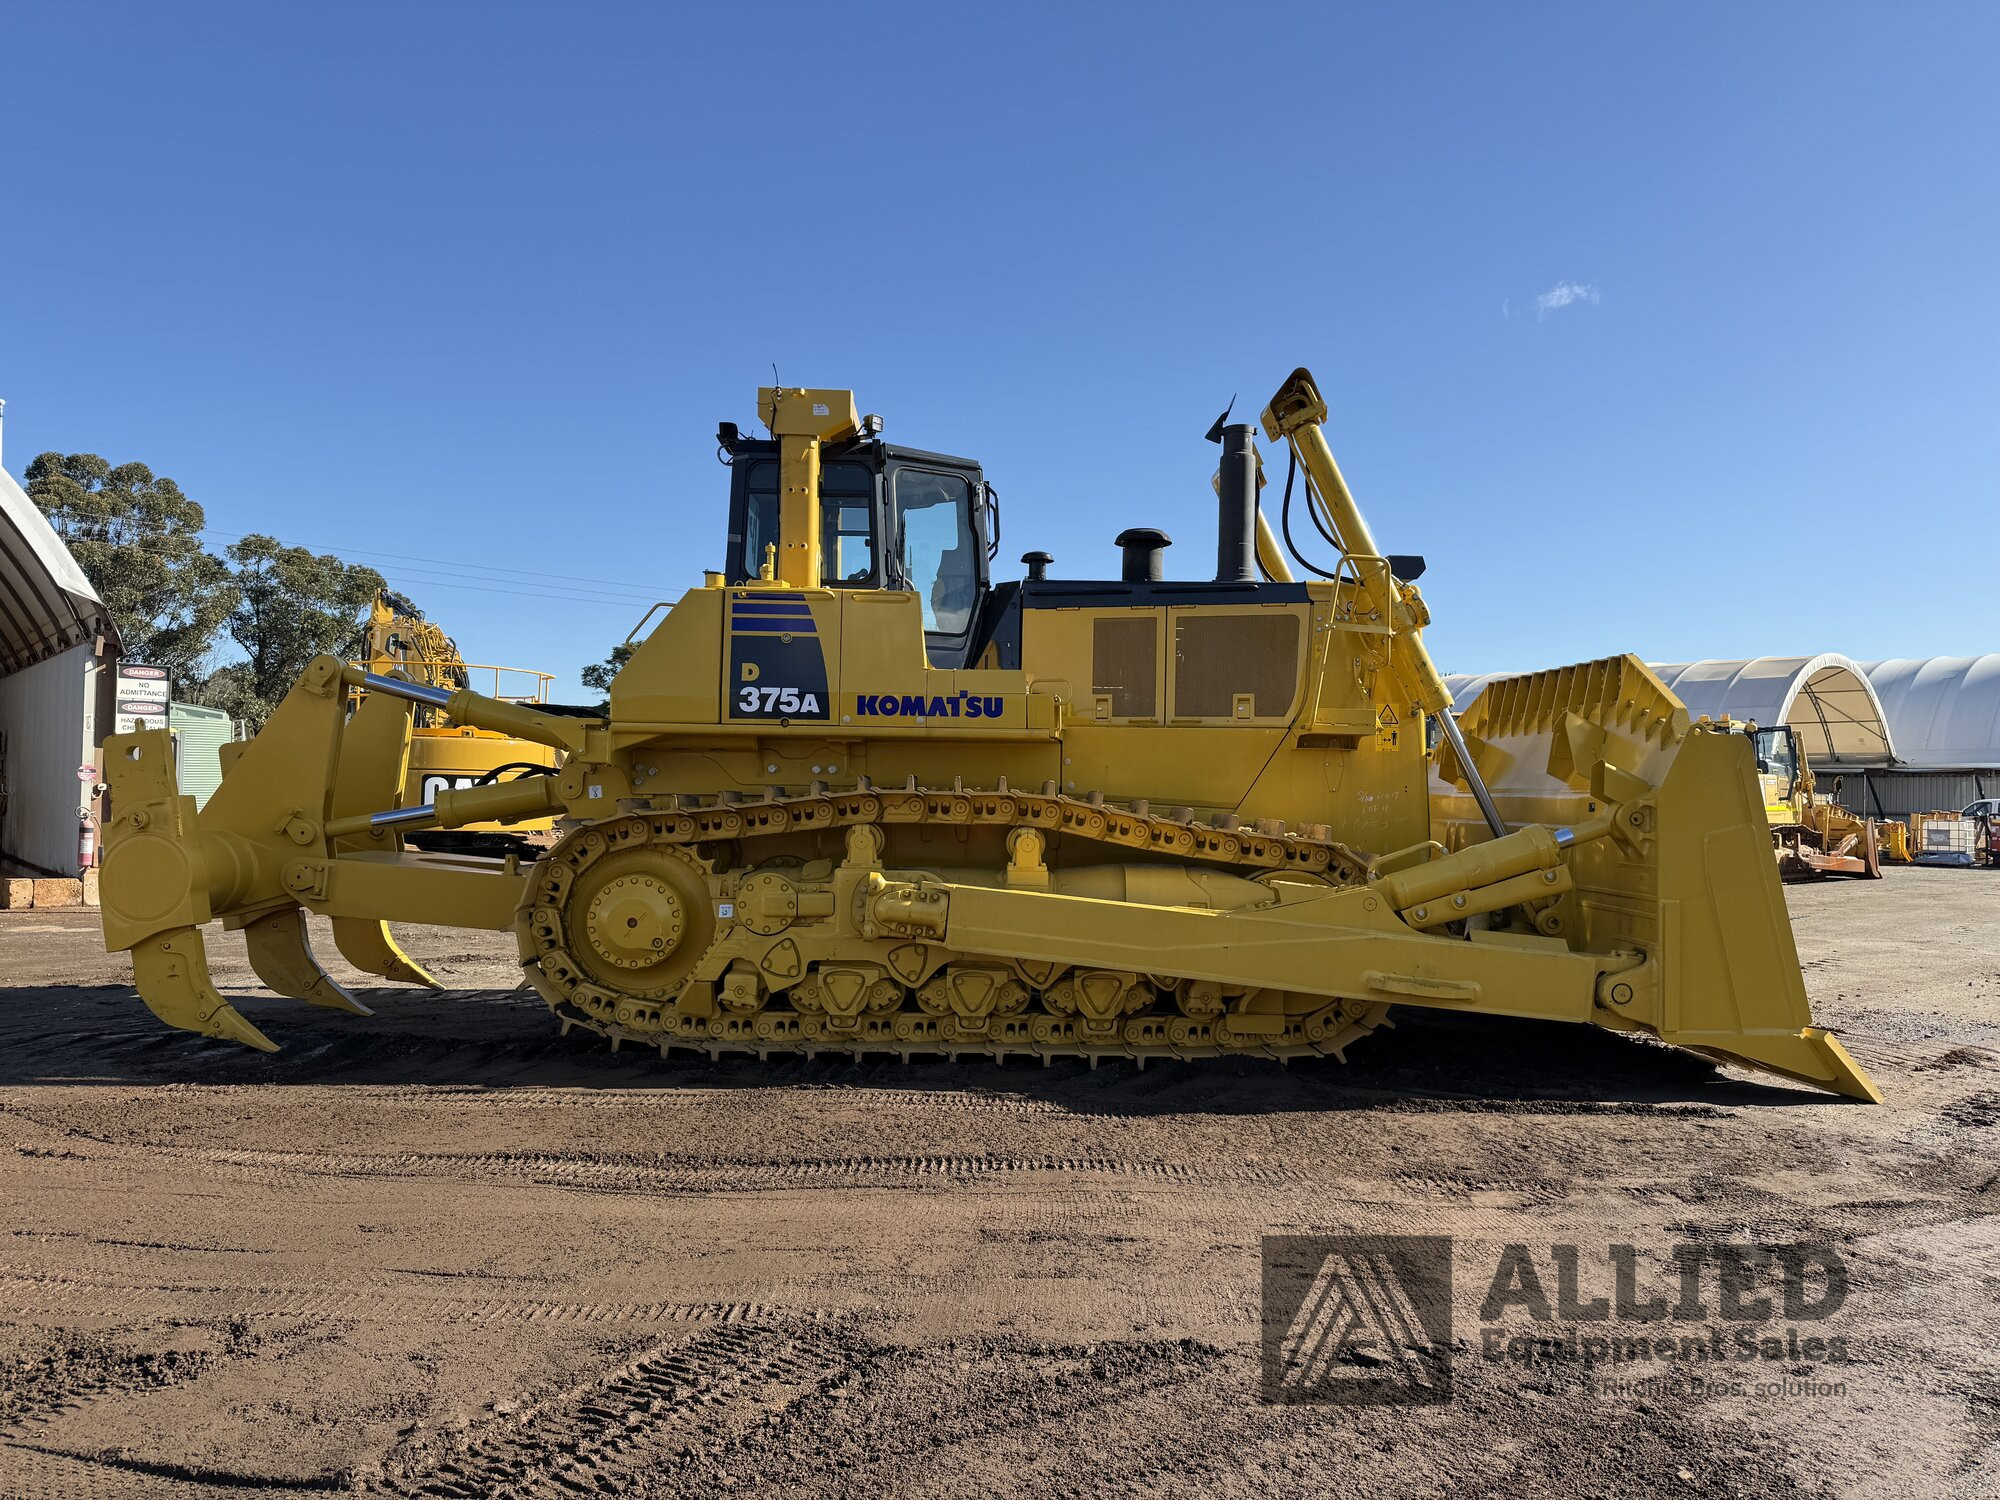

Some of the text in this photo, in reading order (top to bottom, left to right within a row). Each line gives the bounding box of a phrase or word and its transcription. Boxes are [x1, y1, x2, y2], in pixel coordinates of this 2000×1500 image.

[741, 662, 760, 682] D
[120, 689, 168, 697] ADMITTANCE
[739, 686, 820, 714] 375A
[856, 690, 1004, 718] KOMATSU
[120, 717, 164, 725] HAZDOUS
